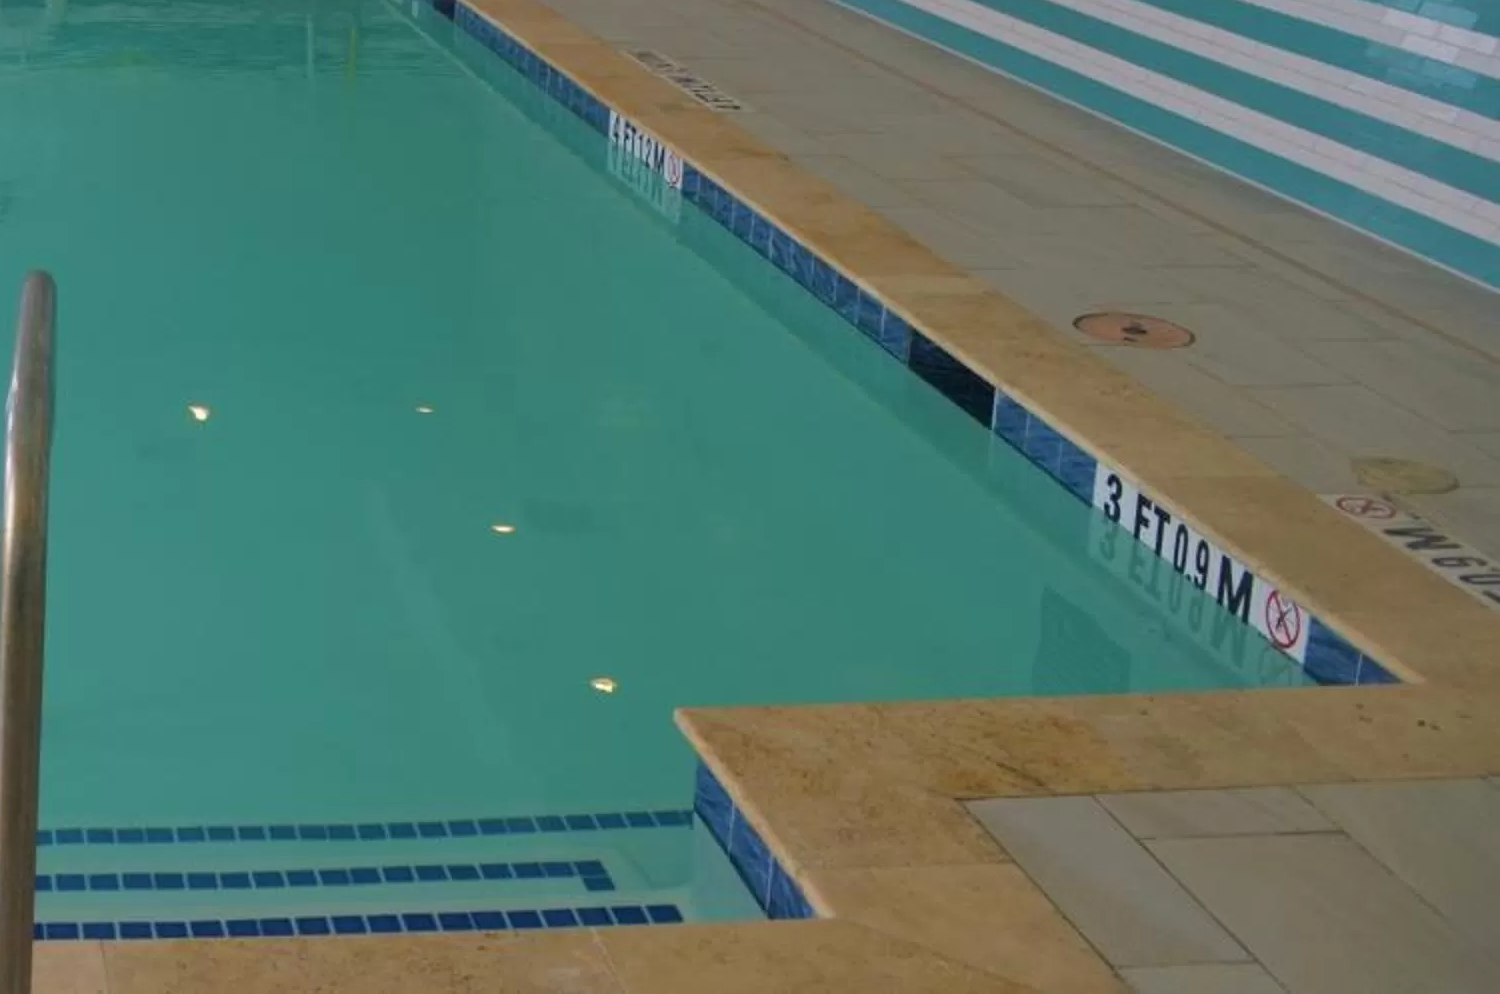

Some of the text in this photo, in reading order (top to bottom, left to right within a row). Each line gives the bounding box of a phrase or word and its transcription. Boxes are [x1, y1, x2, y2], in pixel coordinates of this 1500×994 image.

[1104, 473, 1123, 523] 3
[1133, 493, 1171, 557] FT
[1216, 554, 1254, 625] M
